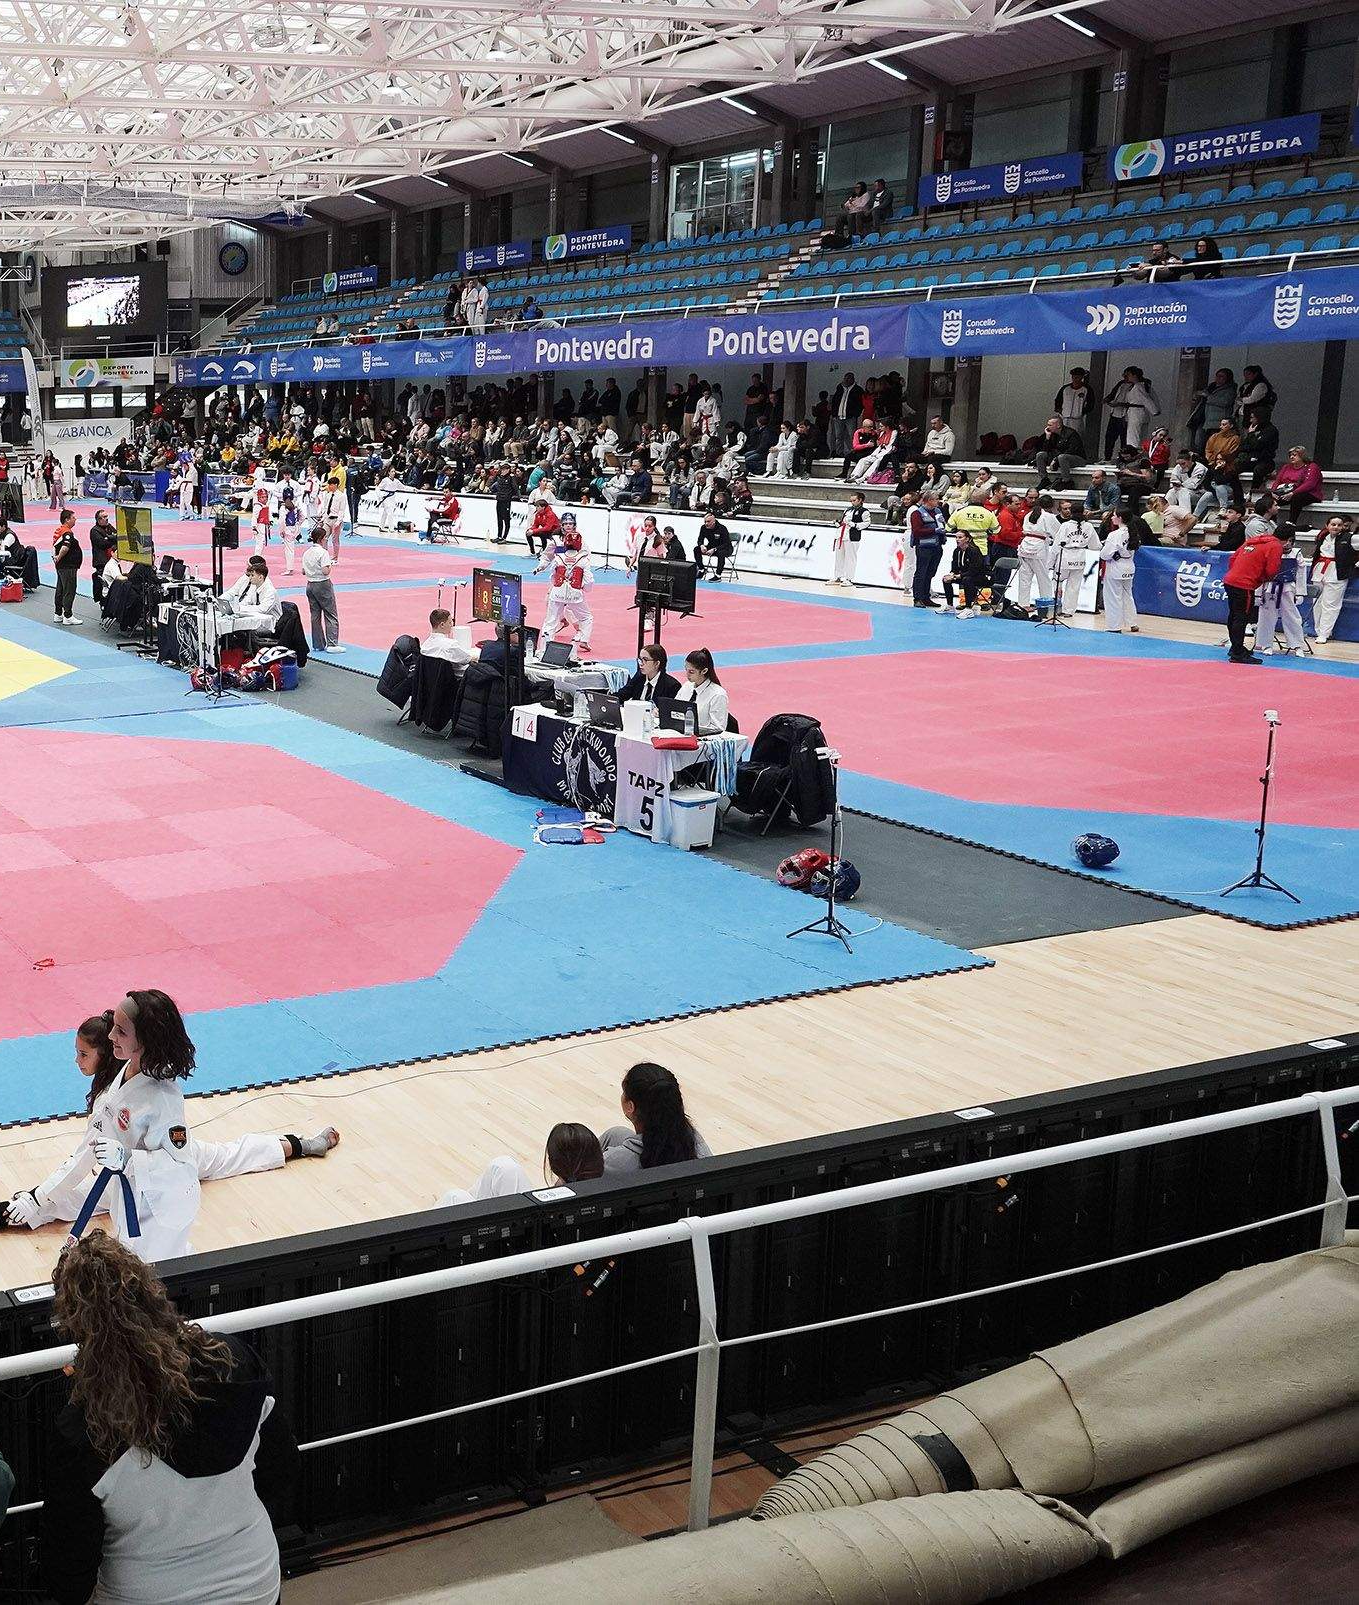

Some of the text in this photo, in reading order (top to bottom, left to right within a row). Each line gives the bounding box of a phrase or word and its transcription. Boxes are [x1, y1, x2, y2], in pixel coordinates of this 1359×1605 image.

[1174, 130, 1262, 153] DEPORTE
[1173, 136, 1303, 165] PONTEVEDRA
[1024, 168, 1050, 177] Concello
[1032, 172, 1066, 183] Pontevedra
[953, 179, 977, 187] Concello
[961, 183, 991, 193] Pontevedra
[570, 232, 608, 244] DEPORTE
[570, 238, 625, 252] PONTEVEDRA
[339, 271, 363, 280] DEPORTE
[339, 277, 374, 286] PONTEVEDRA
[1308, 293, 1354, 305] Concello
[1124, 300, 1188, 317] Deputación
[1306, 307, 1321, 316] de
[966, 317, 997, 328] Concello
[1123, 313, 1187, 327] Pontevedra
[965, 325, 1015, 336] de Pontevedra
[707, 317, 871, 357] Pontevedra
[535, 330, 654, 364] Pontevedra
[482, 590, 489, 604] 8
[1208, 589, 1221, 600] de
[504, 594, 511, 608] 7
[551, 736, 566, 766] CLUB
[639, 795, 655, 831] 5
